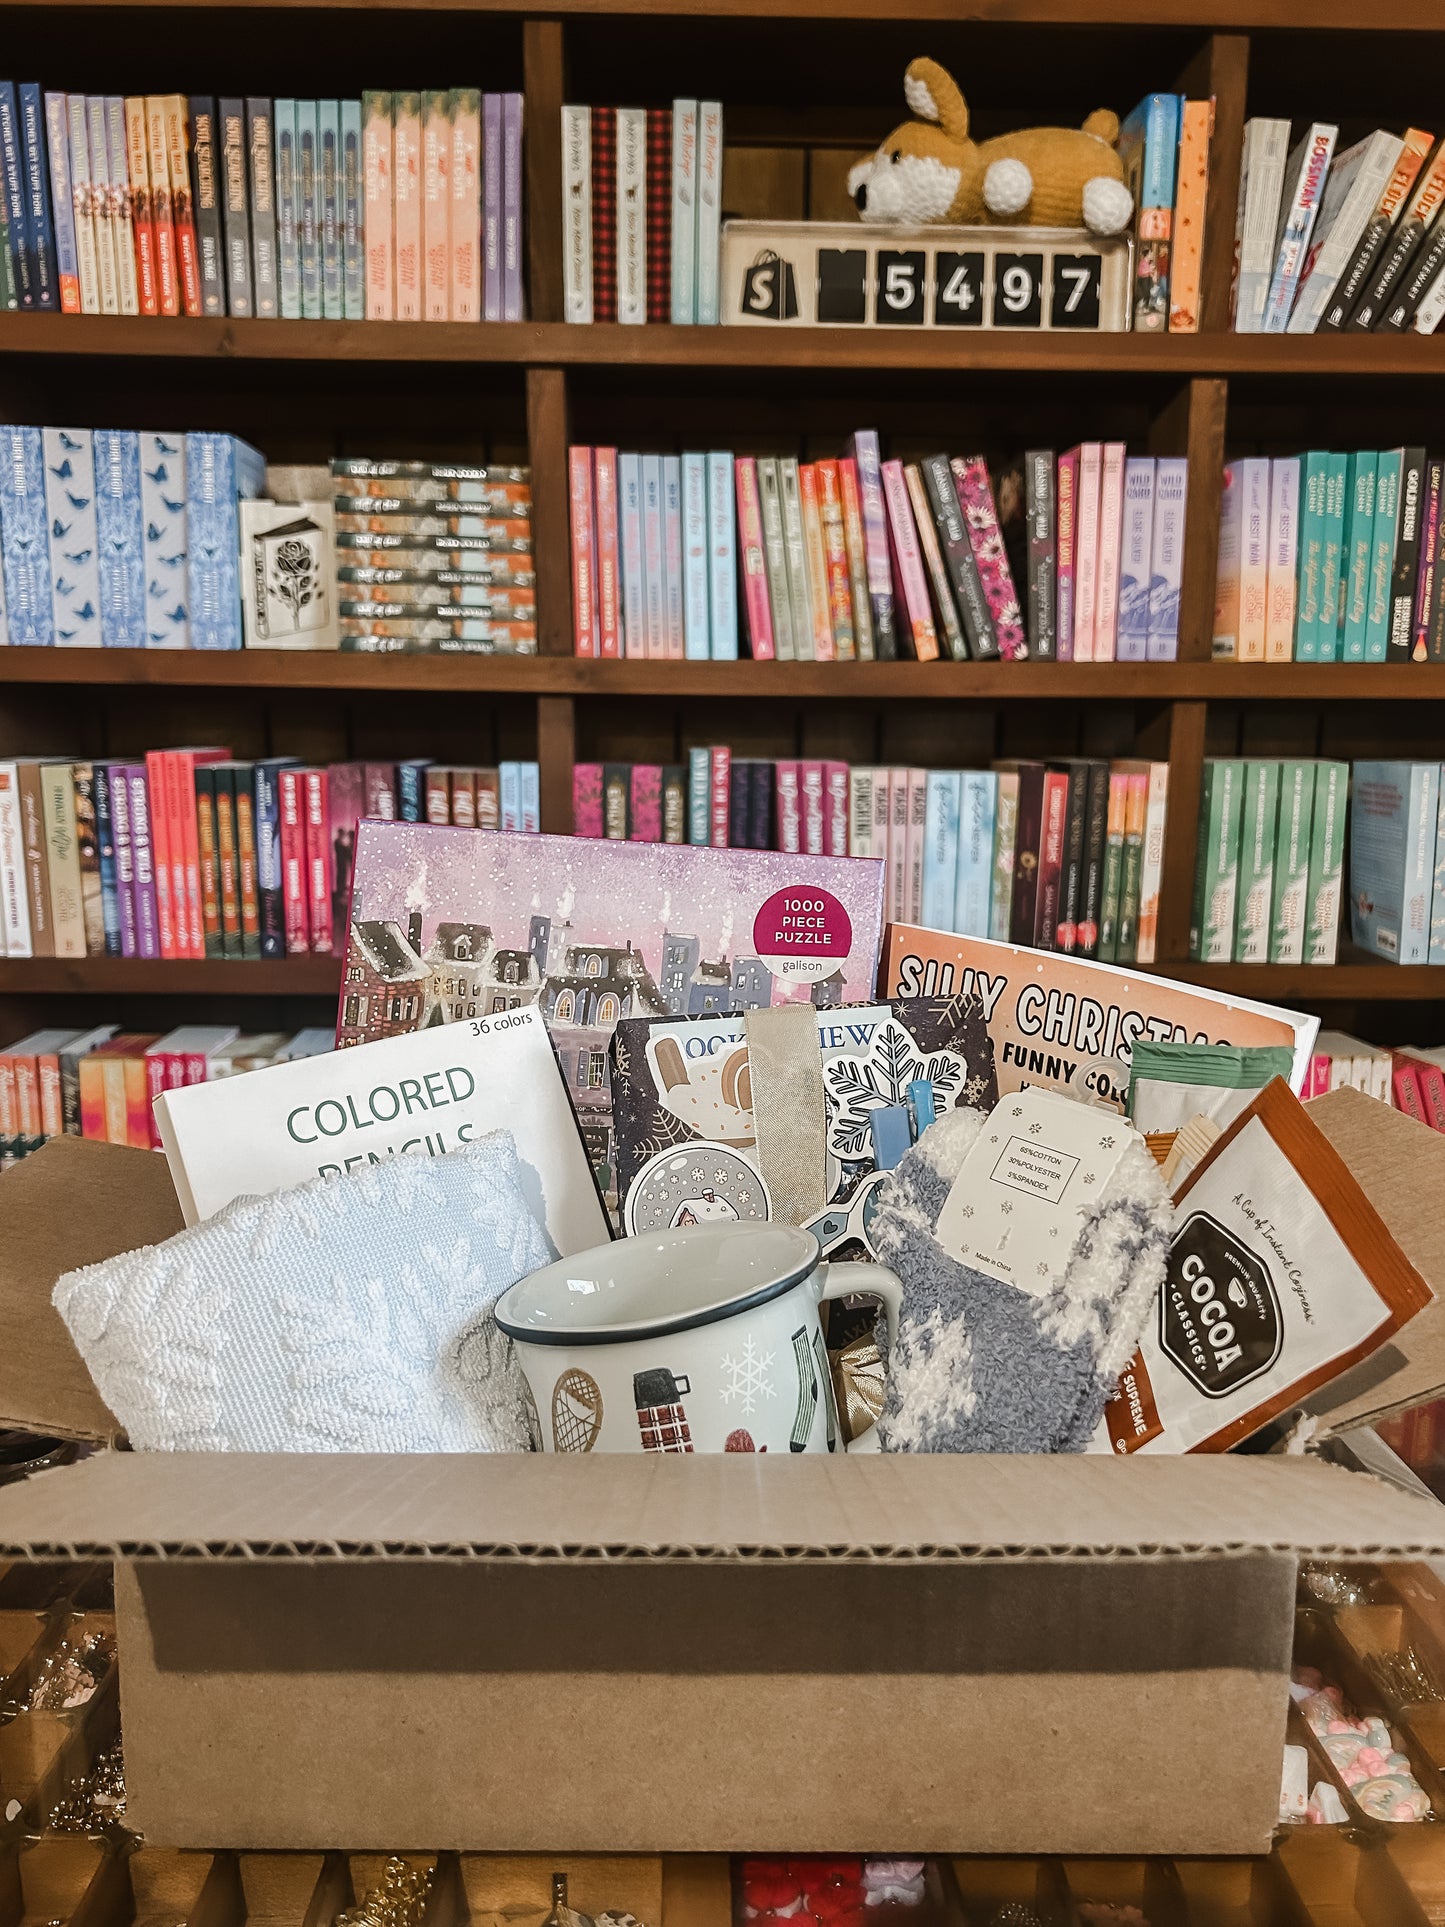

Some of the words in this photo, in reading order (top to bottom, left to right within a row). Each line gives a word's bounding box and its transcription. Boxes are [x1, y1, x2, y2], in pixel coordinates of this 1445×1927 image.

[0, 105, 11, 143] WITCHES
[26, 106, 35, 143] WITCHES
[195, 115, 209, 144] SOUL
[226, 117, 240, 146] SOUL
[253, 117, 267, 146] SOUL
[5, 147, 14, 162] GET
[28, 147, 37, 163] GET
[134, 154, 143, 174] Red
[154, 153, 163, 173] Red
[174, 154, 183, 174] Red
[7, 165, 16, 193] STUFF
[30, 165, 39, 193] STUFF
[194, 146, 214, 209] SEARCHING
[224, 148, 244, 211] SEARCHING
[251, 148, 271, 211] SEARCHING
[367, 169, 377, 200] CUTE
[396, 169, 406, 200] CUTE
[426, 167, 437, 200] CUTE
[454, 167, 464, 200] CUTE
[1299, 136, 1329, 209] BOSSMAN
[11, 195, 20, 218] DONE
[33, 195, 42, 217] DONE
[1379, 170, 1409, 219] FLOCK
[1413, 173, 1444, 221] FLOCK
[1364, 226, 1383, 249] KATE
[1396, 228, 1417, 252] KATE
[884, 265, 1092, 312] 5497
[1343, 251, 1373, 298] STEWART
[1373, 253, 1405, 300] STEWART
[1407, 254, 1437, 300] STEWART
[12, 434, 23, 461] BURN
[109, 438, 120, 463] BURN
[202, 444, 214, 470] BURN
[14, 464, 25, 496] BRIGHT
[111, 466, 121, 499] BRIGHT
[203, 472, 214, 504] BRIGHT
[1308, 475, 1317, 512] QUINN
[1357, 476, 1365, 512] QUINN
[1406, 469, 1418, 503] GOLD
[1431, 466, 1439, 490] LOVE
[1327, 477, 1335, 513] QUINN
[1378, 477, 1387, 513] QUINN
[1403, 505, 1415, 541] RUSH
[1249, 543, 1260, 566] MAN
[1278, 544, 1289, 566] MAN
[691, 753, 709, 795] WILD
[113, 777, 130, 833] STRONG
[130, 777, 147, 834] STRONG
[607, 789, 619, 828] EMILY
[665, 790, 680, 828] EMILY
[692, 796, 708, 840] CARD
[855, 778, 871, 839] SUNSHINE
[119, 835, 130, 846] &
[136, 835, 149, 846] &
[119, 847, 133, 883] WILD
[135, 847, 150, 883] WILD
[782, 916, 825, 928] PIECE
[784, 899, 825, 913] 1000
[775, 931, 832, 944] PUZZLE
[782, 960, 823, 973] galison
[469, 1020, 491, 1037] 36
[493, 1012, 533, 1032] colors
[1016, 983, 1235, 1068] CHRIST
[1002, 1042, 1078, 1084] FUNNY
[286, 1066, 476, 1144] COLORED
[1006, 1171, 1050, 1192] 5%SPANDEX
[1007, 1156, 1062, 1181] 30%POLYESTER
[1233, 1193, 1243, 1205] A
[1240, 1199, 1256, 1221] Cup
[1253, 1215, 1264, 1230] of
[1261, 1225, 1292, 1271] Instant
[974, 1251, 990, 1264] Made
[996, 1260, 1012, 1272] China
[1223, 1251, 1250, 1282] PREMIUM
[1247, 1280, 1267, 1321] QUALITY
[1171, 1290, 1206, 1365] CLASSICS
[1181, 1254, 1243, 1373] COCOA
[1123, 1374, 1148, 1437] SUPREME
